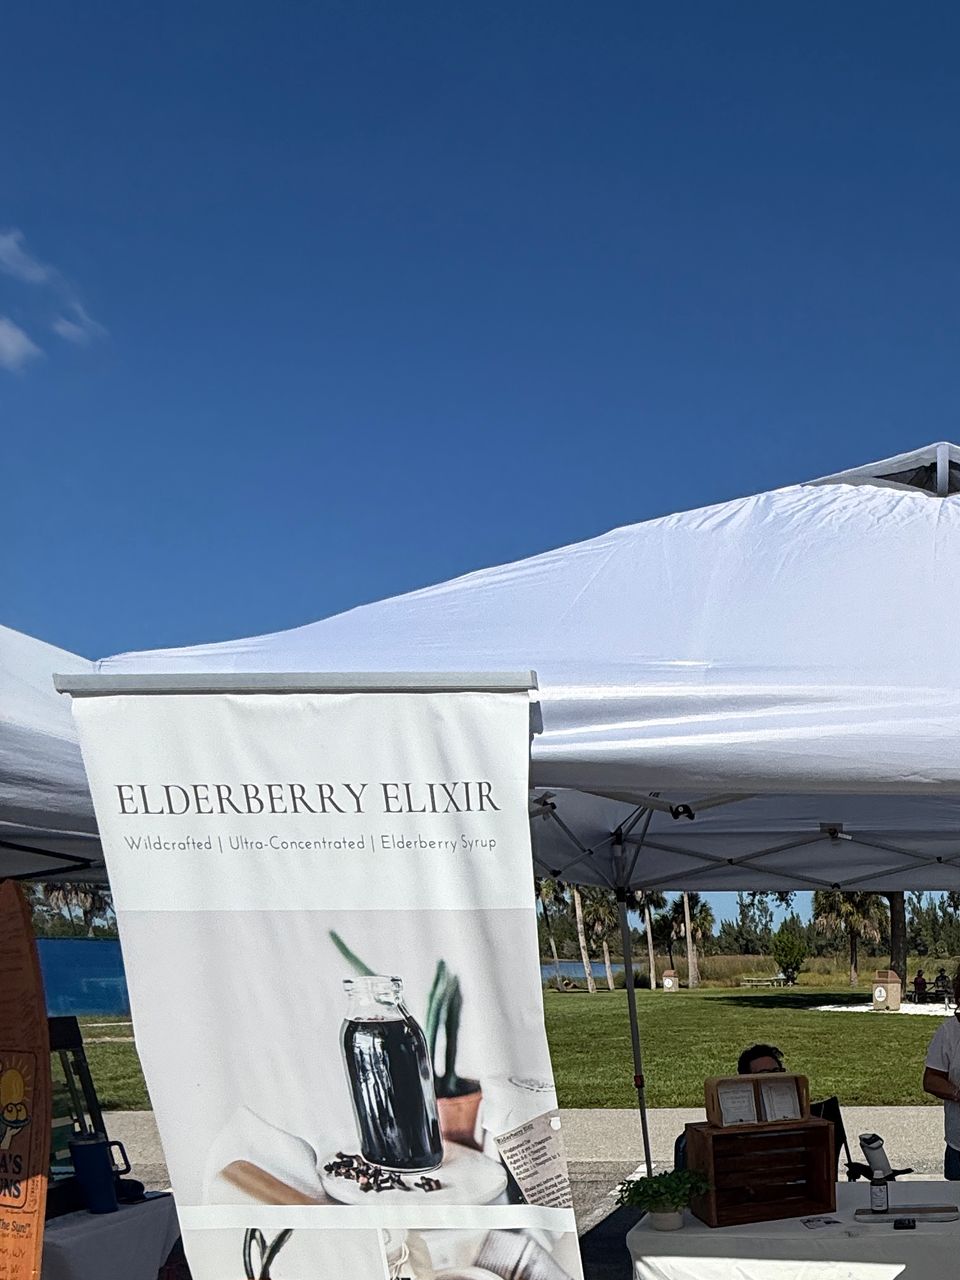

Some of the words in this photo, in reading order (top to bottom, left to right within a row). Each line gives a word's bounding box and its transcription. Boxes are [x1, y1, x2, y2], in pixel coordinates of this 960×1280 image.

[114, 783, 369, 815] ELDERBERRY
[379, 781, 502, 813] ELIXIR
[124, 835, 212, 851] Wildcrafted
[229, 835, 365, 850] Ultra-Concentrated
[381, 834, 457, 853] Elderberry
[461, 834, 497, 853] Syrup
